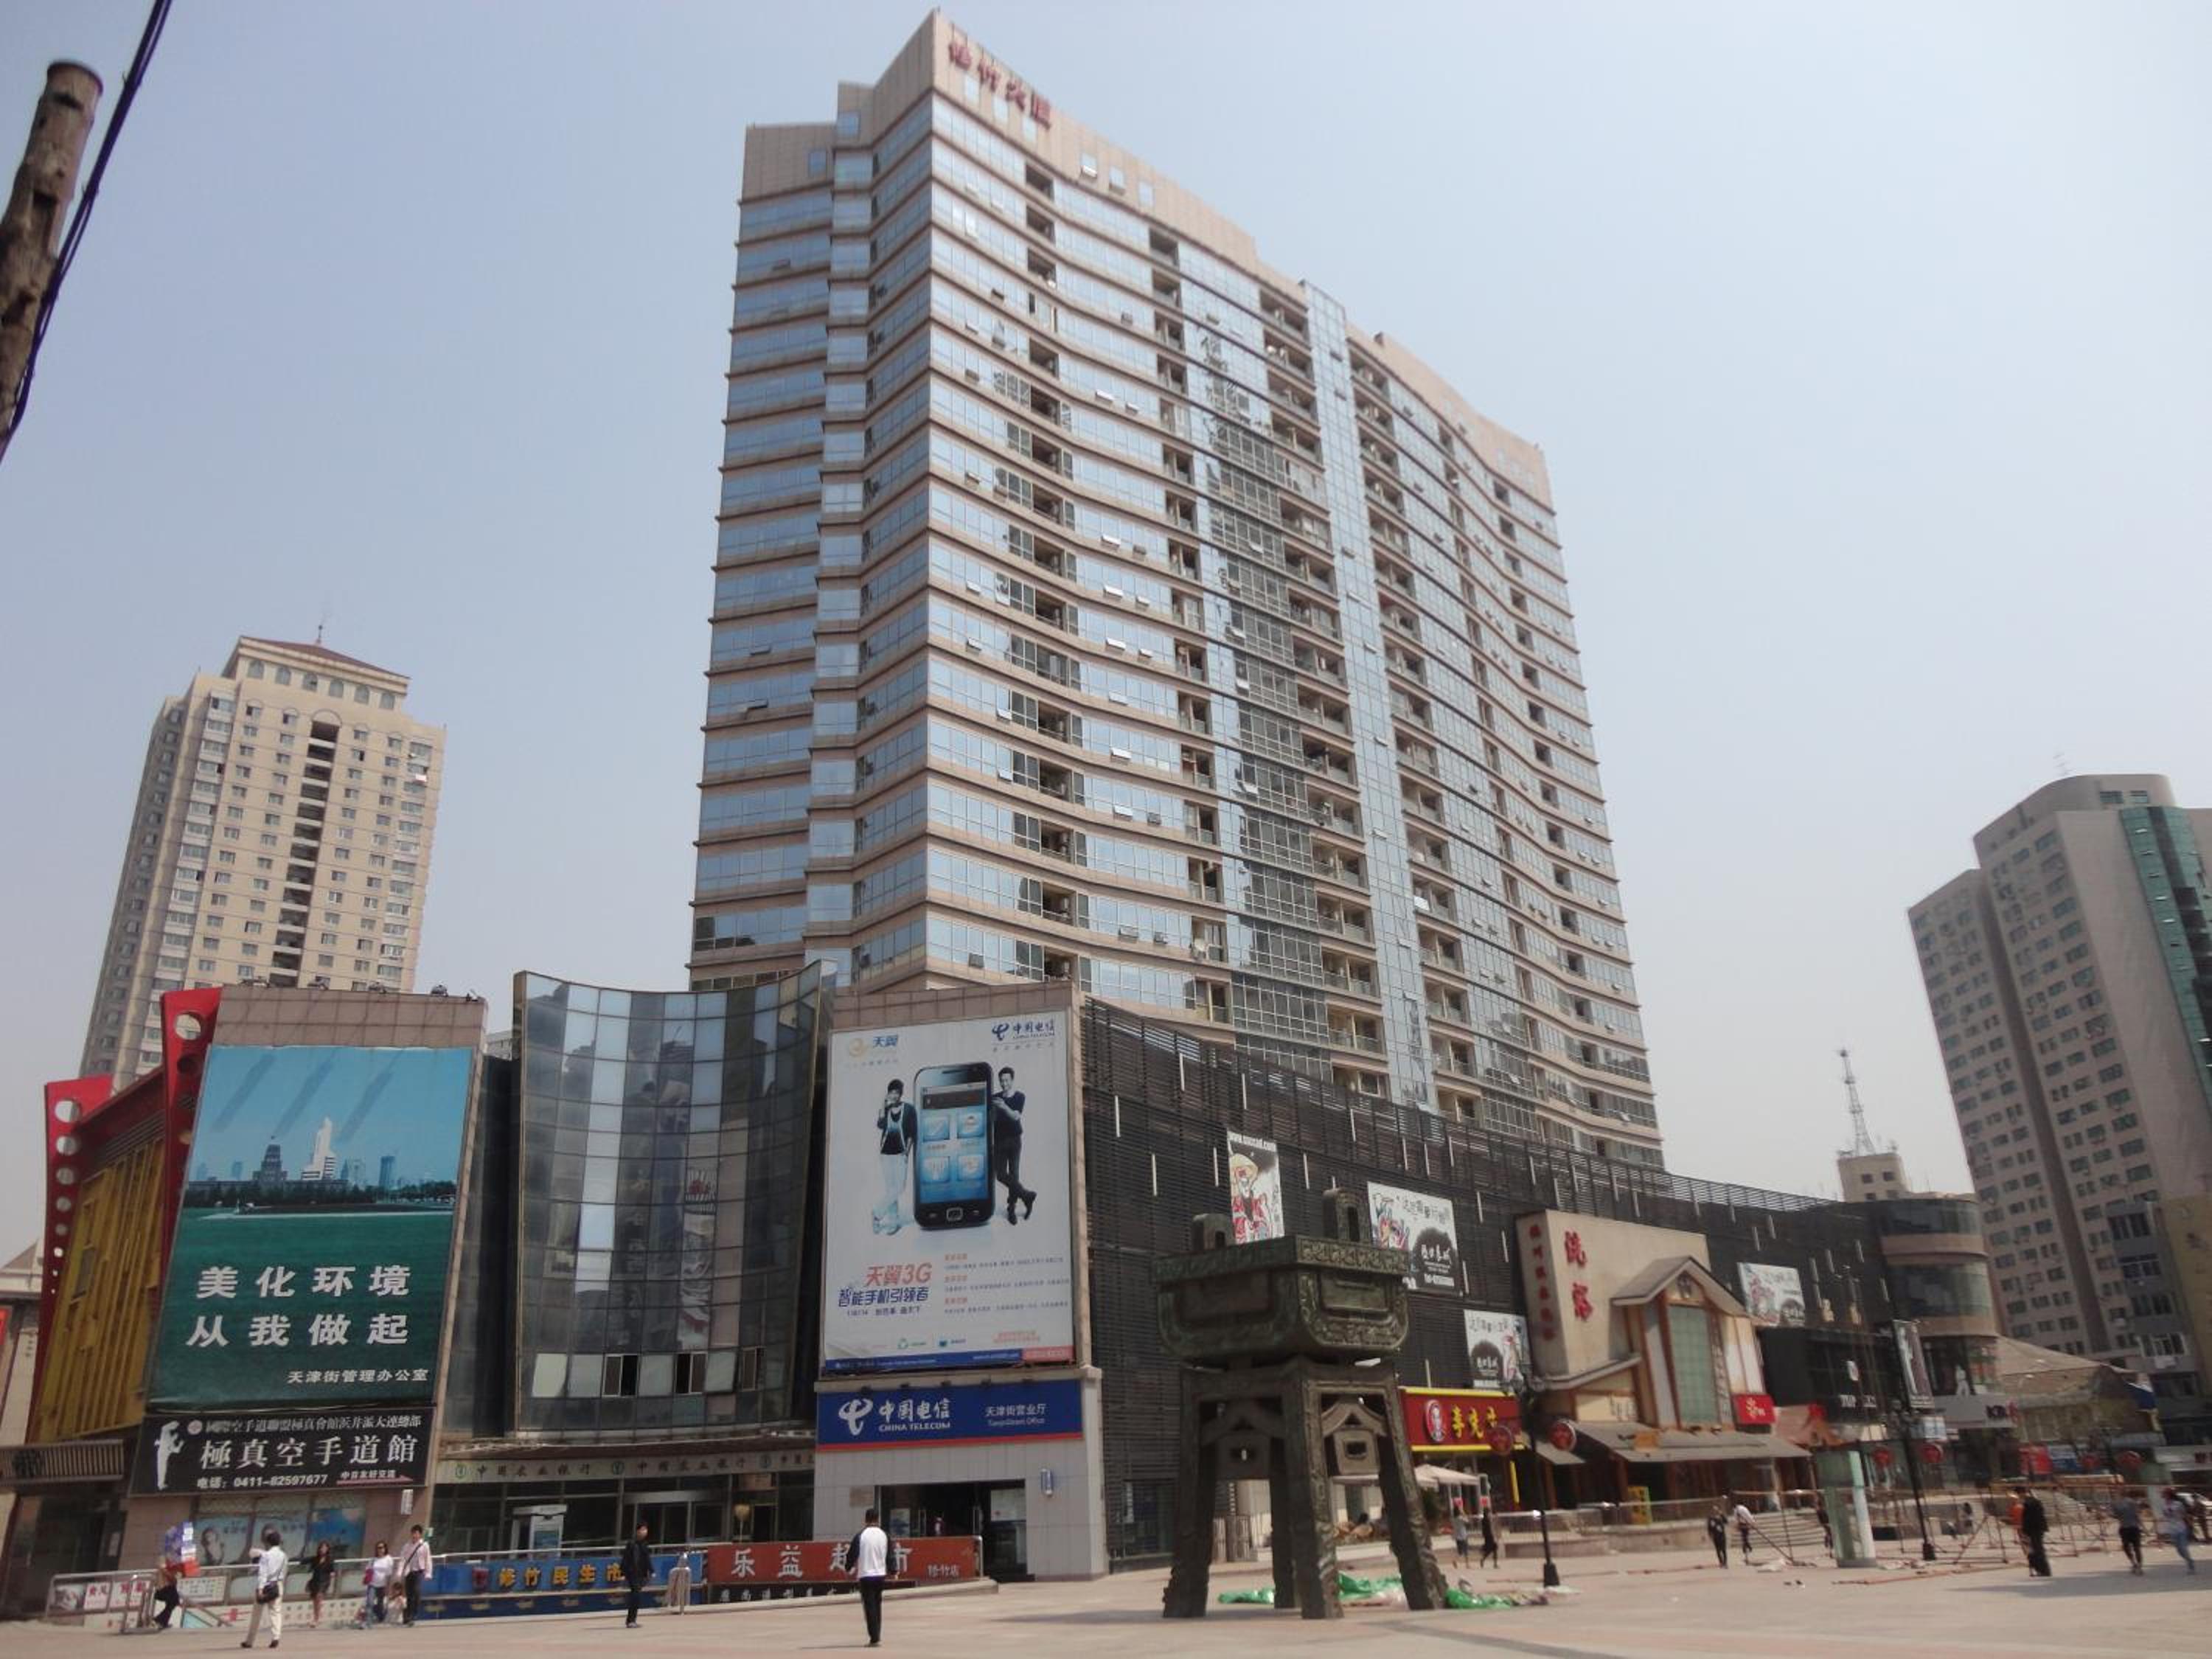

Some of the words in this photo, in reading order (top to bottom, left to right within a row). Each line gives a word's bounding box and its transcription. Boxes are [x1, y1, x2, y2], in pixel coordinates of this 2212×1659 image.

[197, 1265, 411, 1298] 美化环境
[838, 1286, 929, 1307] 智能手机引领者
[187, 1312, 408, 1347] 从我做起
[287, 1368, 428, 1384] 天津街管理办公室
[879, 1398, 950, 1423] 中国电信
[878, 1424, 908, 1432] CHINA
[909, 1421, 950, 1430] TELECOM
[200, 1435, 418, 1470] 極真空手道館
[498, 1563, 626, 1587] 修竹民生市
